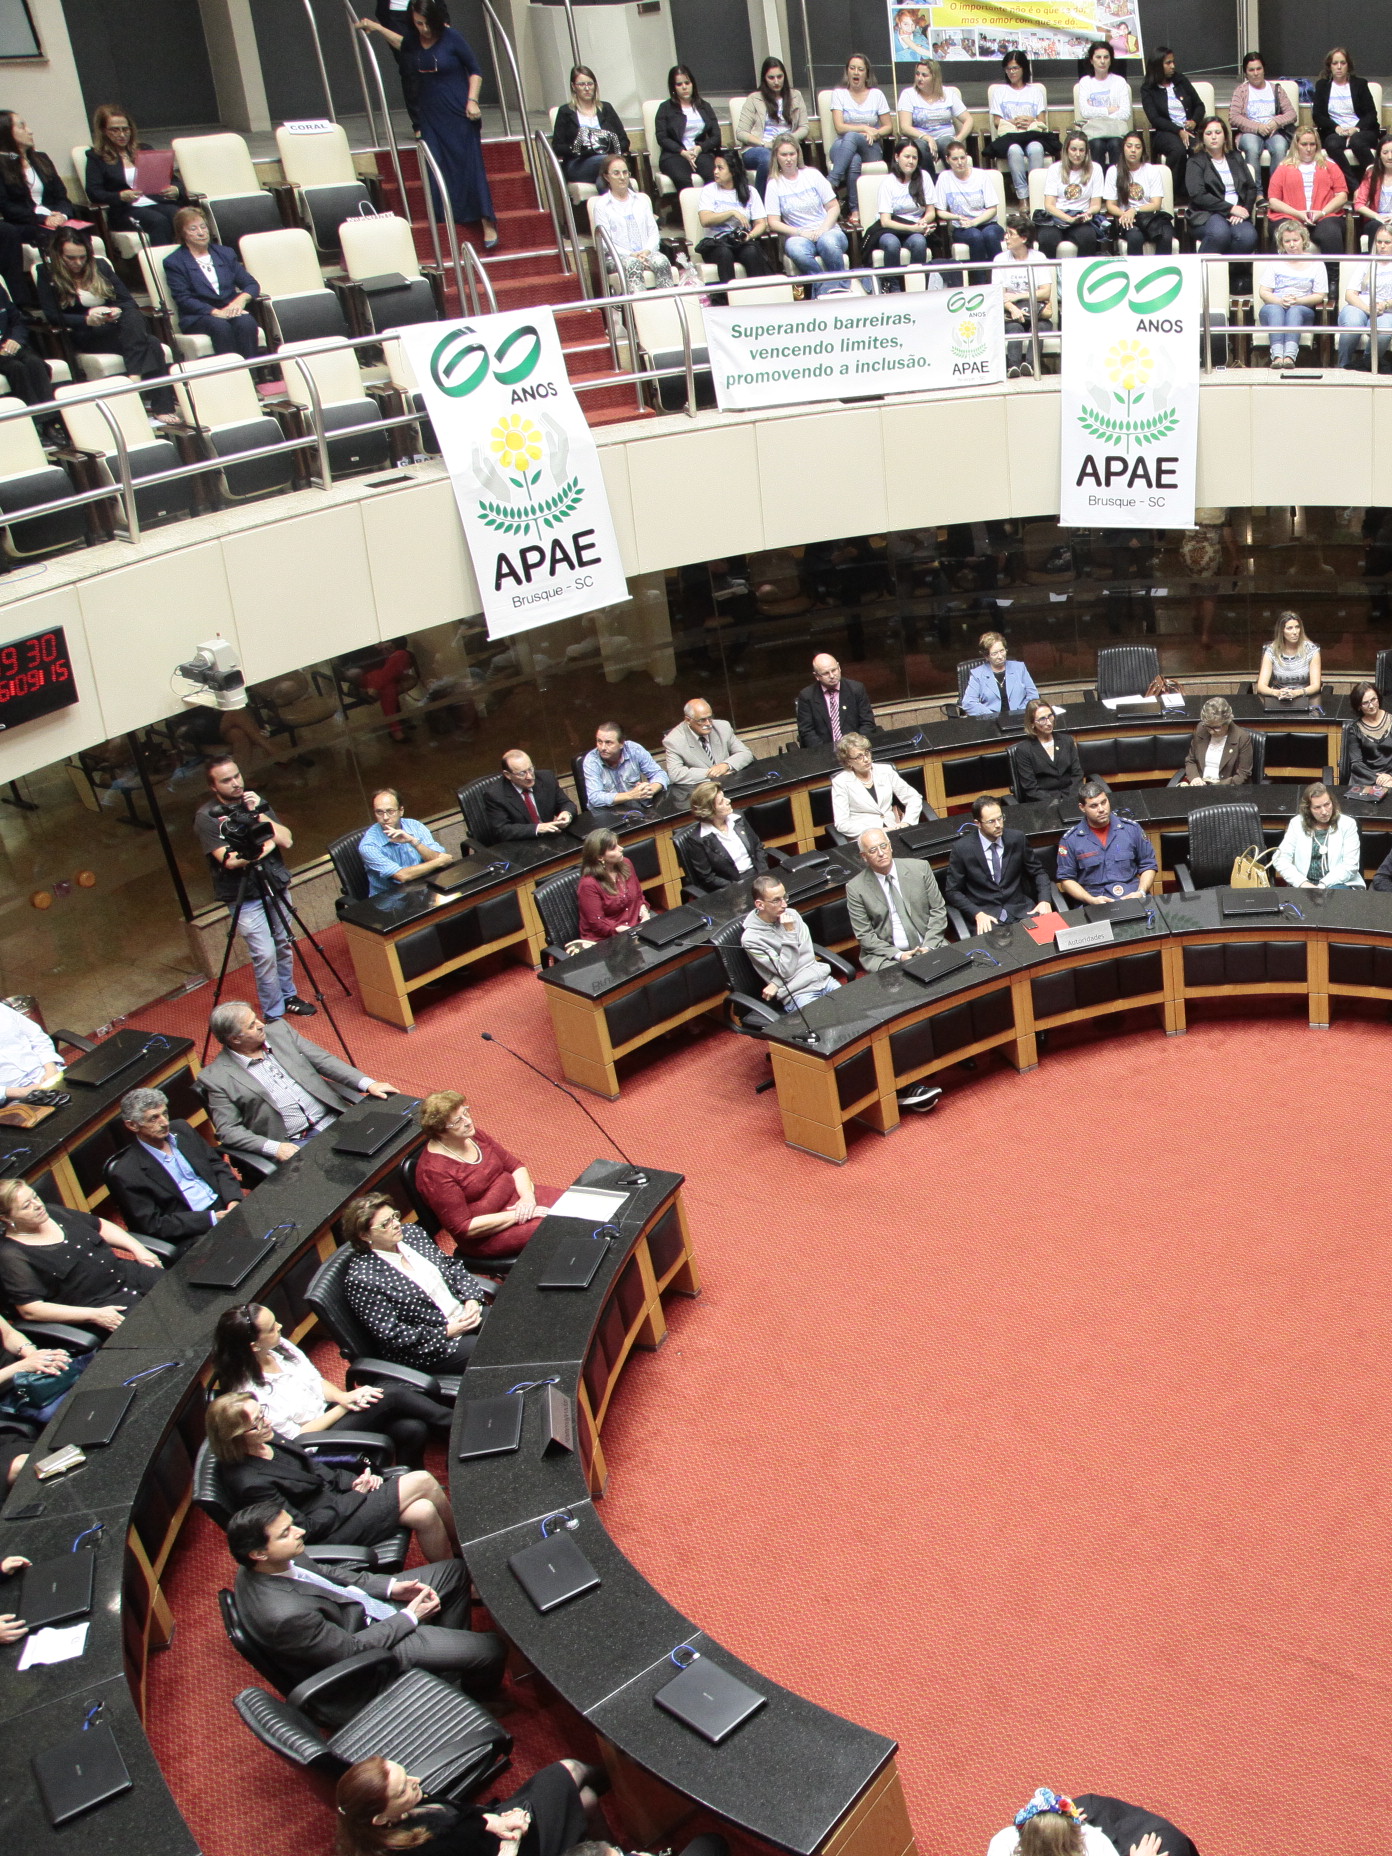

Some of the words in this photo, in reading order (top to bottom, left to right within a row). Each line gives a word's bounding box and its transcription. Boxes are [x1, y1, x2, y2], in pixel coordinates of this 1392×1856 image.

[290, 123, 328, 131] CORAL
[731, 318, 828, 341] Superando
[834, 312, 917, 331] barreiras,
[1136, 319, 1184, 333] ANOS
[750, 340, 835, 361] vencendo
[840, 336, 904, 353] limites,
[726, 363, 834, 390] promovendo
[839, 364, 850, 375] a
[856, 354, 932, 374] inclusão.
[952, 360, 990, 376] APAE
[511, 382, 558, 405] ANOS
[1076, 454, 1180, 489] APAE
[1088, 495, 1137, 508] Brusque
[1147, 496, 1166, 508] SC
[494, 528, 602, 592] APAE
[511, 585, 564, 609] Brusque
[574, 575, 594, 591] SC
[0, 646, 19, 677] 9
[1067, 933, 1105, 947] Autoridades
